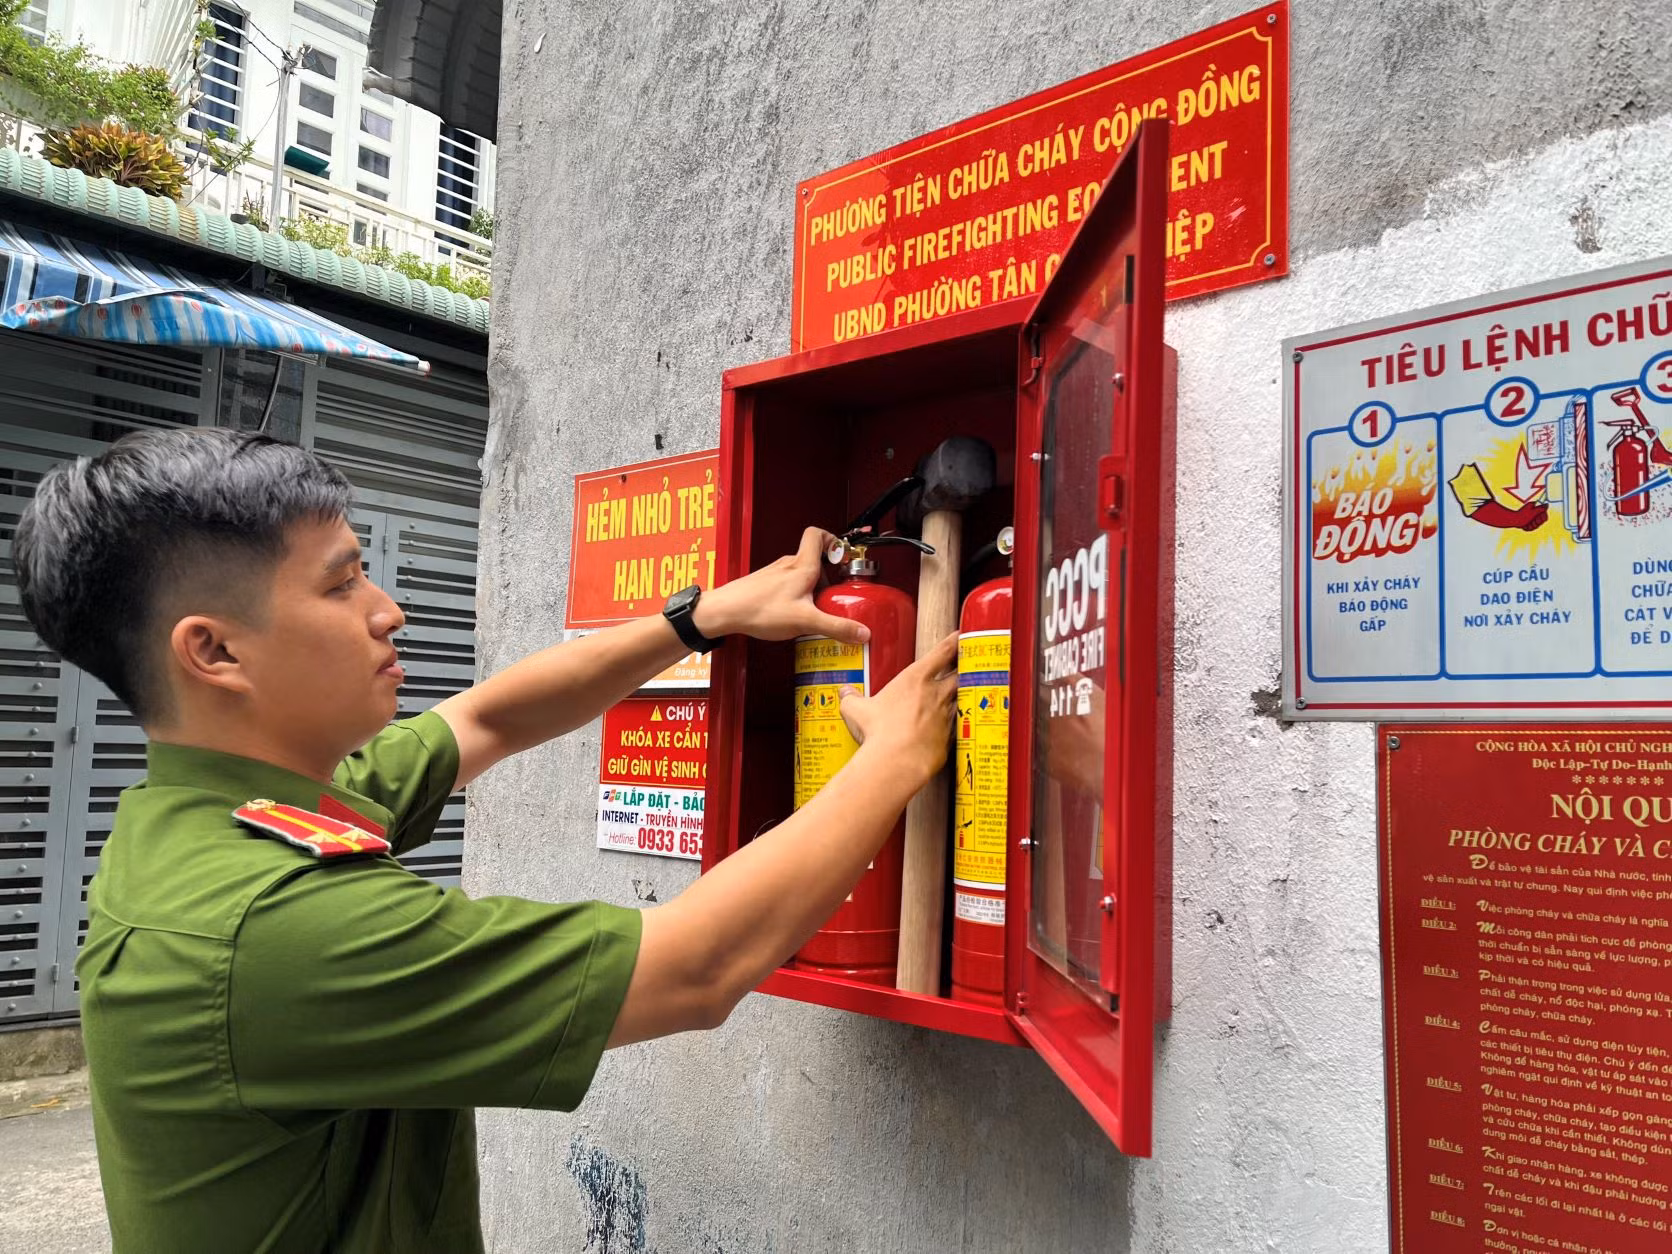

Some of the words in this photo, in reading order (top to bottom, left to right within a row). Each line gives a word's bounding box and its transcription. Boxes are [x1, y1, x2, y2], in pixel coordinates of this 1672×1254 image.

[810, 194, 887, 246] PHƯƠNG
[893, 172, 941, 218] TIỆN
[948, 148, 1009, 200] CHỮA
[1017, 122, 1085, 177] CHÁY
[1177, 63, 1261, 127] ĐỒNG
[827, 244, 897, 292] PUBLIC
[903, 194, 1059, 270] FIREFIGHTING
[834, 302, 886, 343] UBND
[894, 275, 981, 328] PHƯỜNG
[989, 257, 1036, 302] TÂN
[1361, 342, 1446, 388] TIÊU
[1462, 324, 1569, 372] LỆNH
[1362, 410, 1378, 438] 1
[1500, 386, 1526, 418] 2
[586, 487, 626, 542] HẺM
[632, 477, 671, 537] NHỎ
[678, 469, 714, 531] TRẺ
[1334, 482, 1393, 518] BÁO
[1314, 512, 1418, 560] ĐỘNG
[613, 558, 654, 609] HẠN
[1327, 582, 1349, 594] KHI
[1353, 576, 1379, 592] XẢY
[1384, 575, 1421, 590] CHÁY
[1483, 568, 1513, 584] CÚP
[1339, 598, 1366, 613] BÁO
[1370, 597, 1408, 613] ĐỘNG
[1480, 592, 1510, 605] DAO
[1516, 587, 1554, 605] ĐIỆN
[1360, 615, 1386, 632] GẤP
[1464, 614, 1488, 627] NƠI
[1495, 609, 1524, 626] XẢY
[1530, 608, 1571, 625] CHÁY
[666, 702, 694, 720] CHÚ
[698, 702, 706, 720] Ý
[621, 726, 652, 747] KHÓA
[656, 731, 670, 747] XE
[674, 722, 700, 748] CẨN
[1476, 739, 1514, 752] CỘNG
[1518, 739, 1548, 752] HÒA
[1551, 739, 1571, 752] XÃ
[1575, 739, 1602, 754] HỘI
[1605, 739, 1637, 753] CHỦ
[608, 755, 628, 775] GIỮ
[631, 755, 651, 776] GÌN
[655, 756, 668, 782] VỆ
[671, 761, 699, 778] SINH
[1532, 759, 1556, 770] Độc
[624, 787, 645, 806] LẮP
[648, 791, 670, 811] ĐẶT
[1551, 787, 1614, 824] NỘI
[602, 810, 638, 824] INTERNET
[681, 814, 703, 830] HÌNH
[609, 832, 636, 845] Hotline:
[638, 827, 674, 852] 0933
[1448, 826, 1532, 850] PHÒNG
[1538, 832, 1607, 855] CHÁY
[1615, 834, 1645, 857] VÀ
[1563, 885, 1583, 895] Nay
